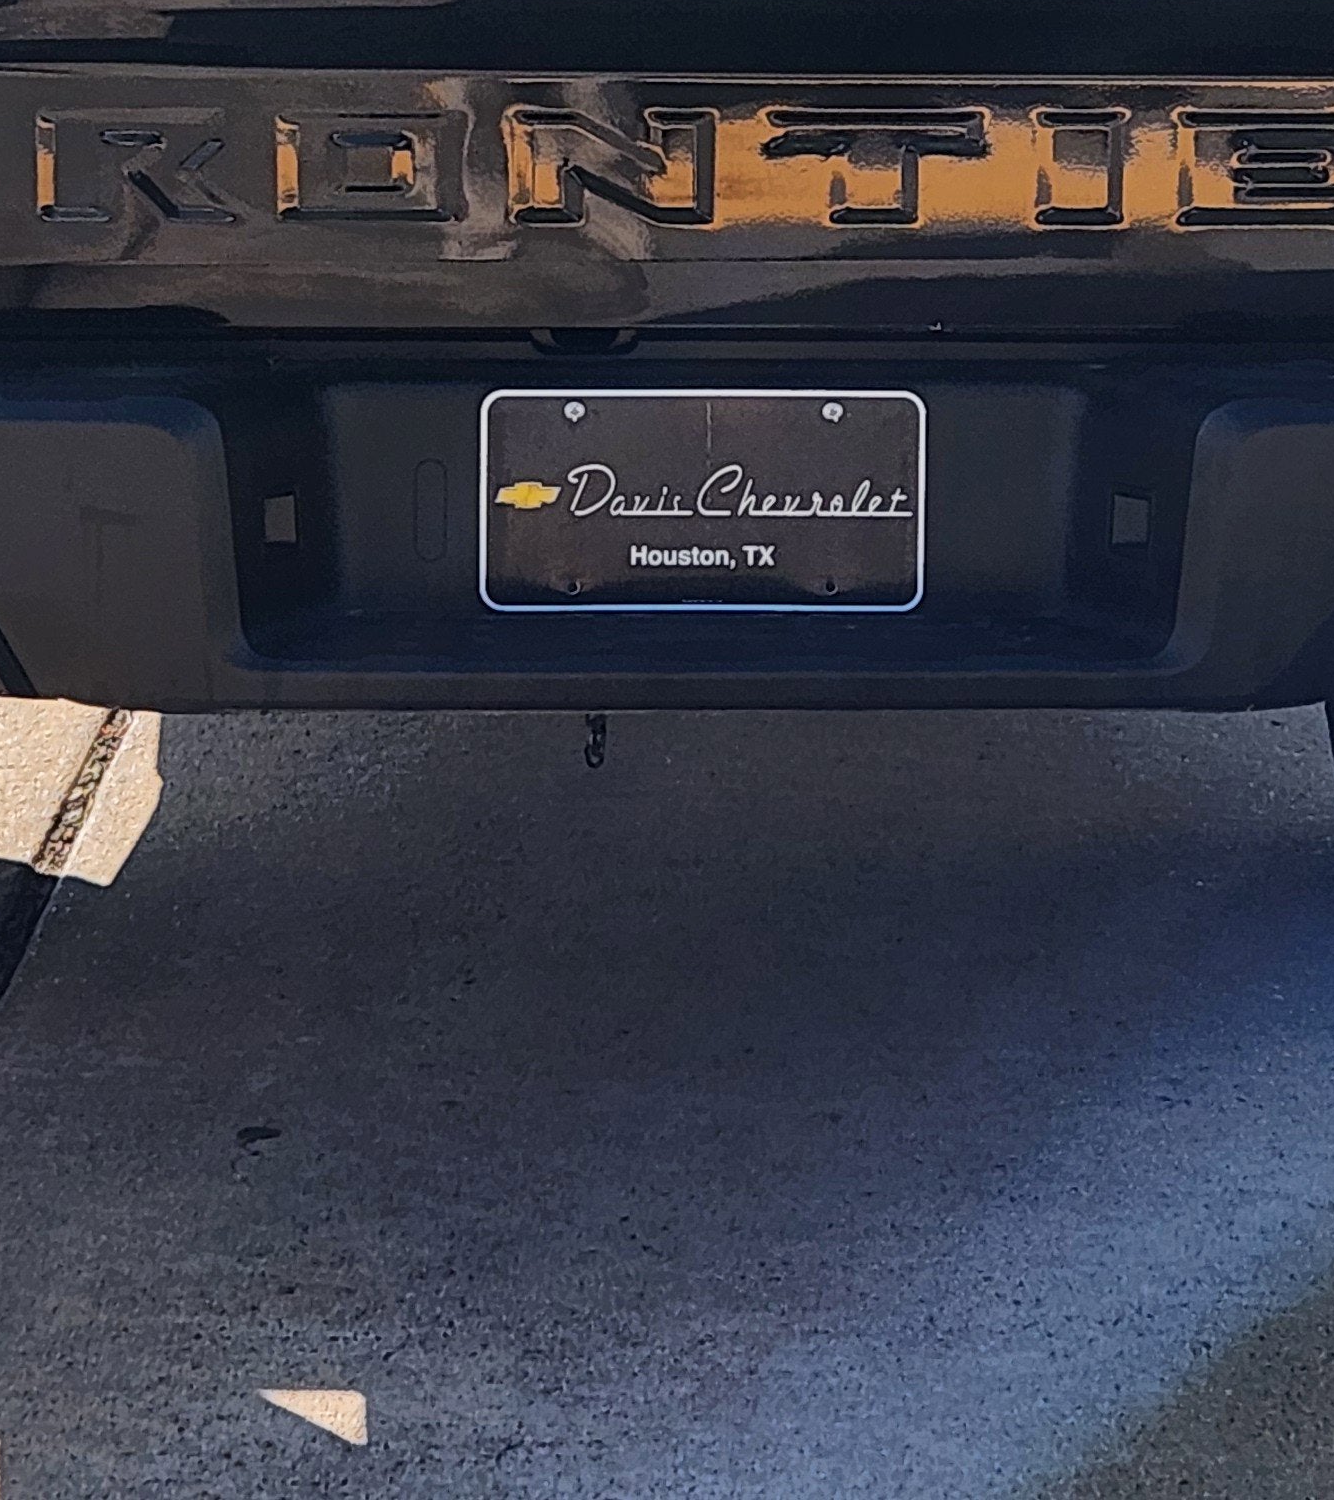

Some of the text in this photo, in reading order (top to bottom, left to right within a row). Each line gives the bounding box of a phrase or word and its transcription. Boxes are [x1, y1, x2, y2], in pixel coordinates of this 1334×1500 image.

[567, 463, 913, 517] Davis Chevrolet
[630, 545, 775, 569] Houston, TX
